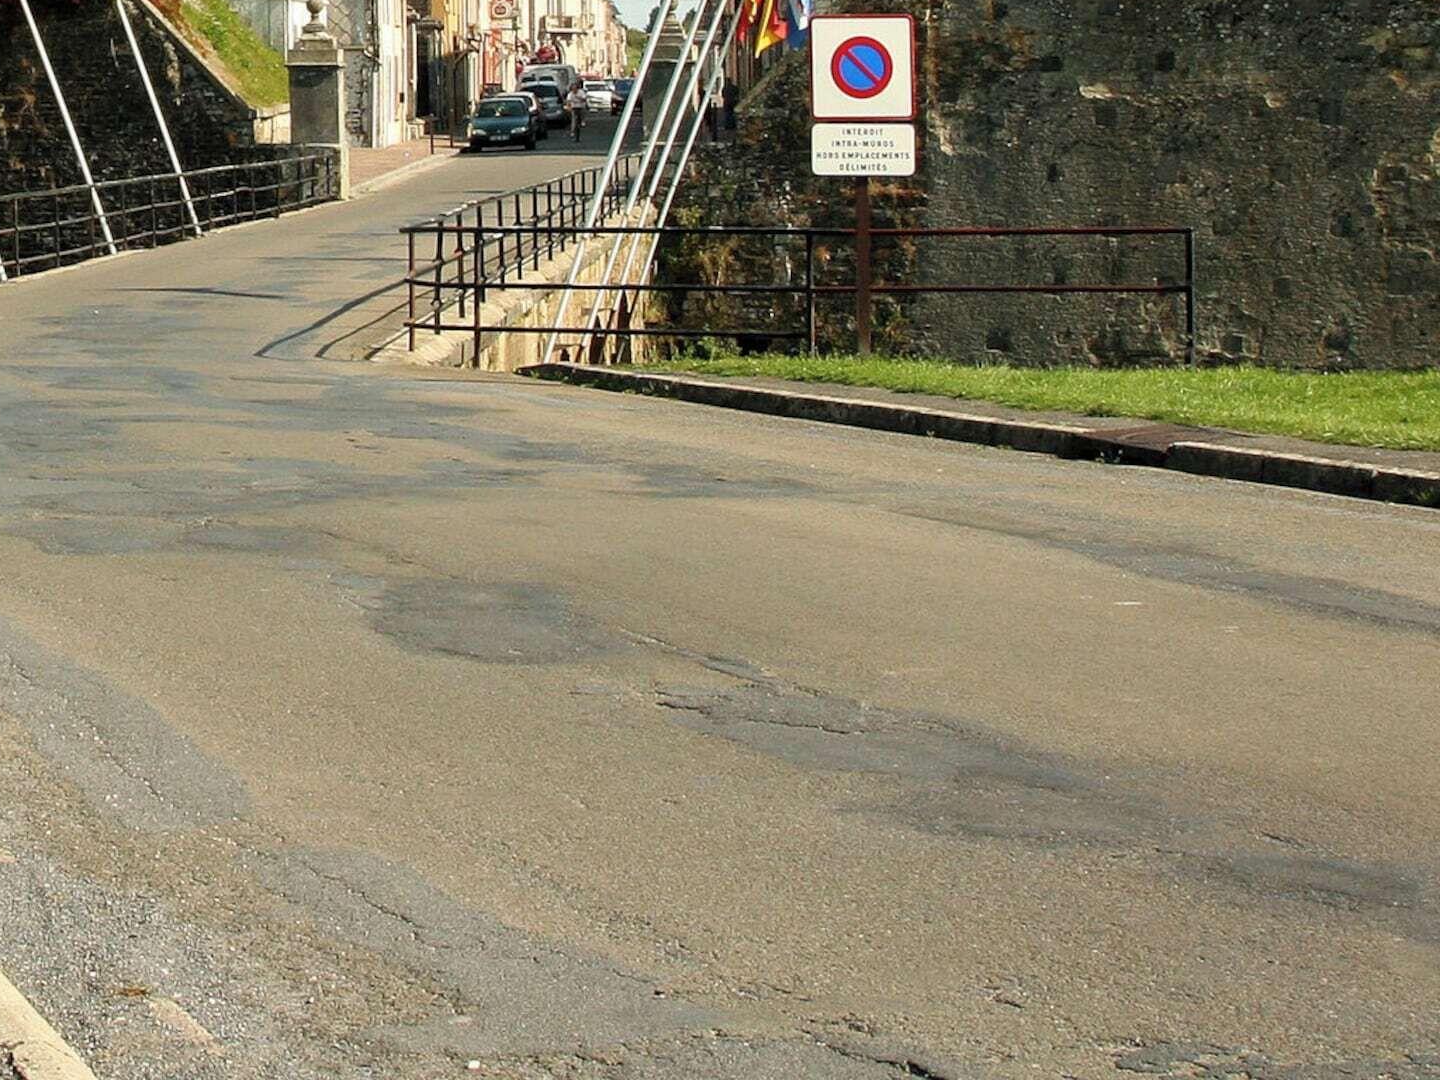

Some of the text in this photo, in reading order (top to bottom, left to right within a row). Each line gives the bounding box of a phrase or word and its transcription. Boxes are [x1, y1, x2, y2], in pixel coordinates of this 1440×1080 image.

[841, 128, 884, 136] INTERDIT
[831, 140, 895, 148] INTRA-MUROS
[816, 152, 911, 160] HORS EMPLACEMENTS
[839, 163, 887, 172] DÉLIMITÉS
